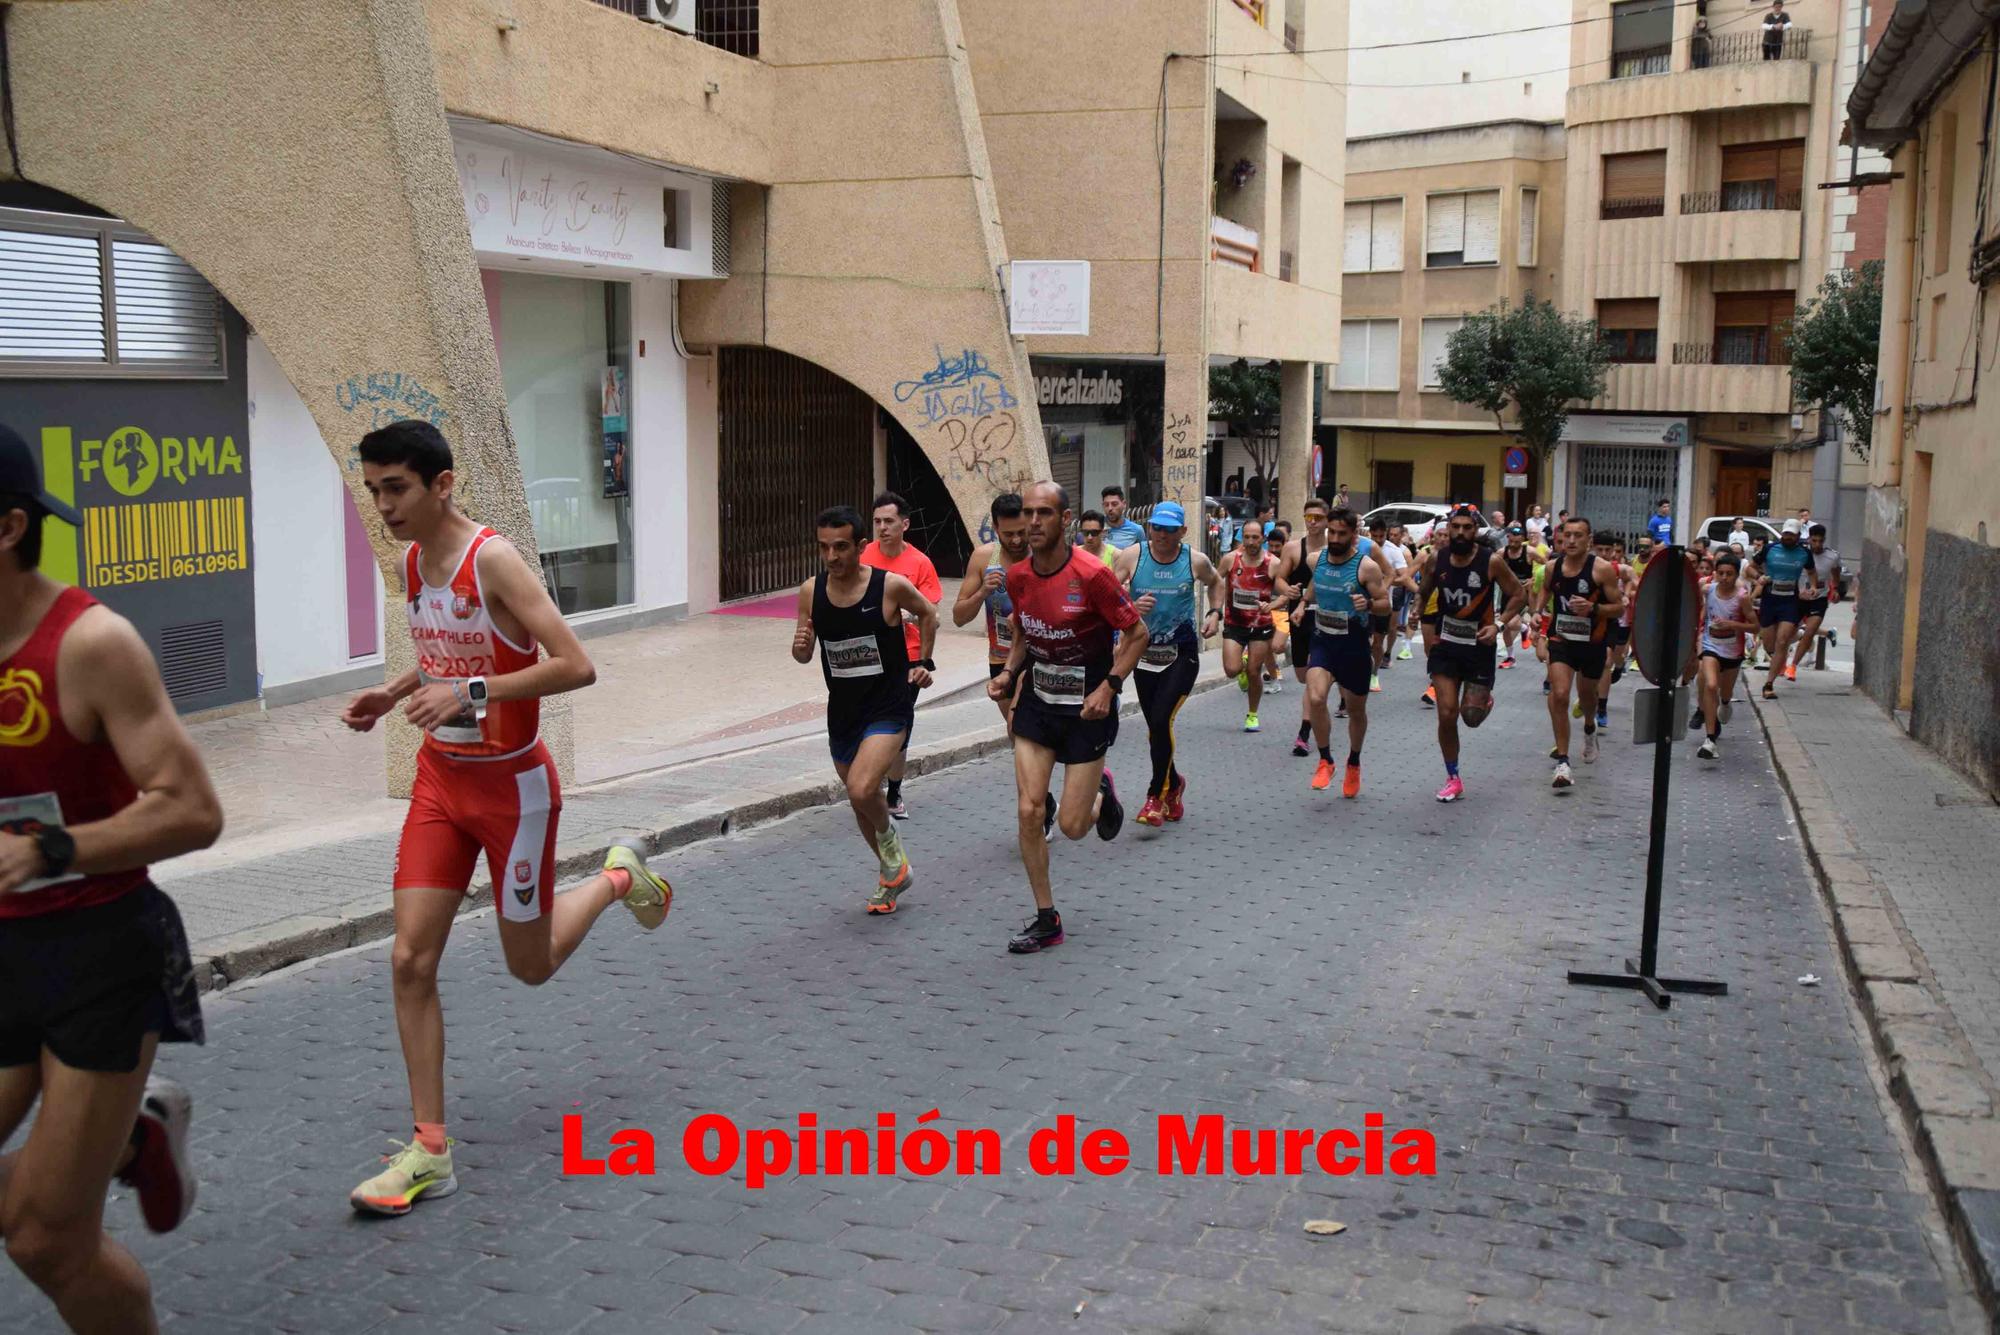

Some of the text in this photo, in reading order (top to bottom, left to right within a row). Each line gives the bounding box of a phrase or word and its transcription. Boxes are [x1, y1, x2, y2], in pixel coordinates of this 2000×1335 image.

[99, 552, 239, 587] DESDE 061096
[832, 646, 873, 662] 1012
